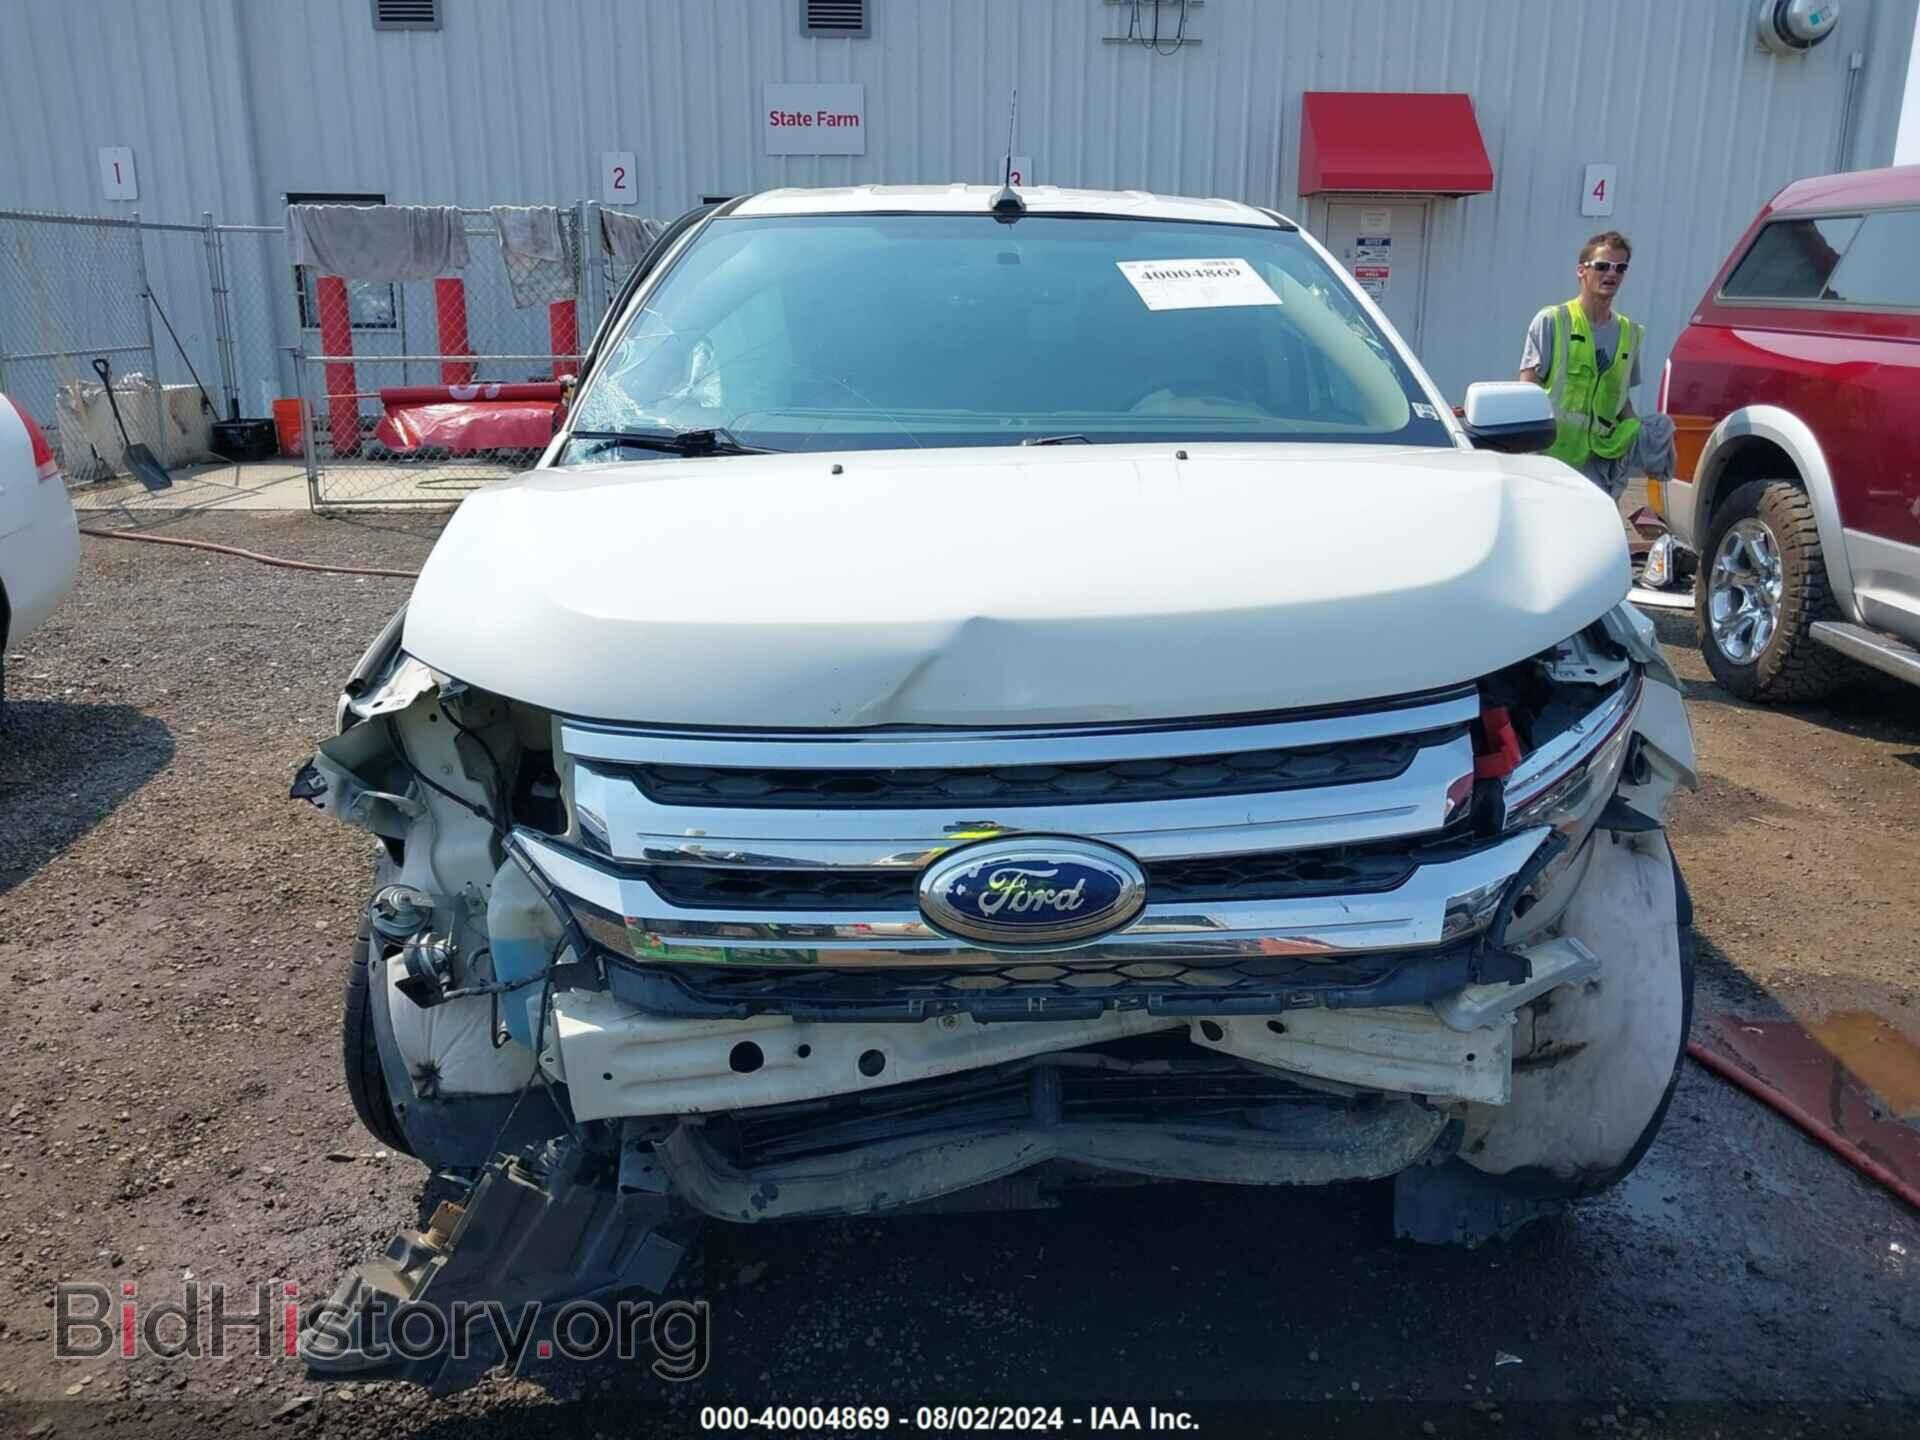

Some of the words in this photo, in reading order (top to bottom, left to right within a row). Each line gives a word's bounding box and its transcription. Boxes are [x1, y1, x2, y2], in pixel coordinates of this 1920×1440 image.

[769, 110, 813, 127] State
[816, 110, 860, 127] Farm
[113, 162, 121, 185] 1
[613, 167, 626, 189] 2
[1592, 179, 1605, 201] 4
[1141, 267, 1241, 281] 40004869
[977, 867, 1087, 917] Ford
